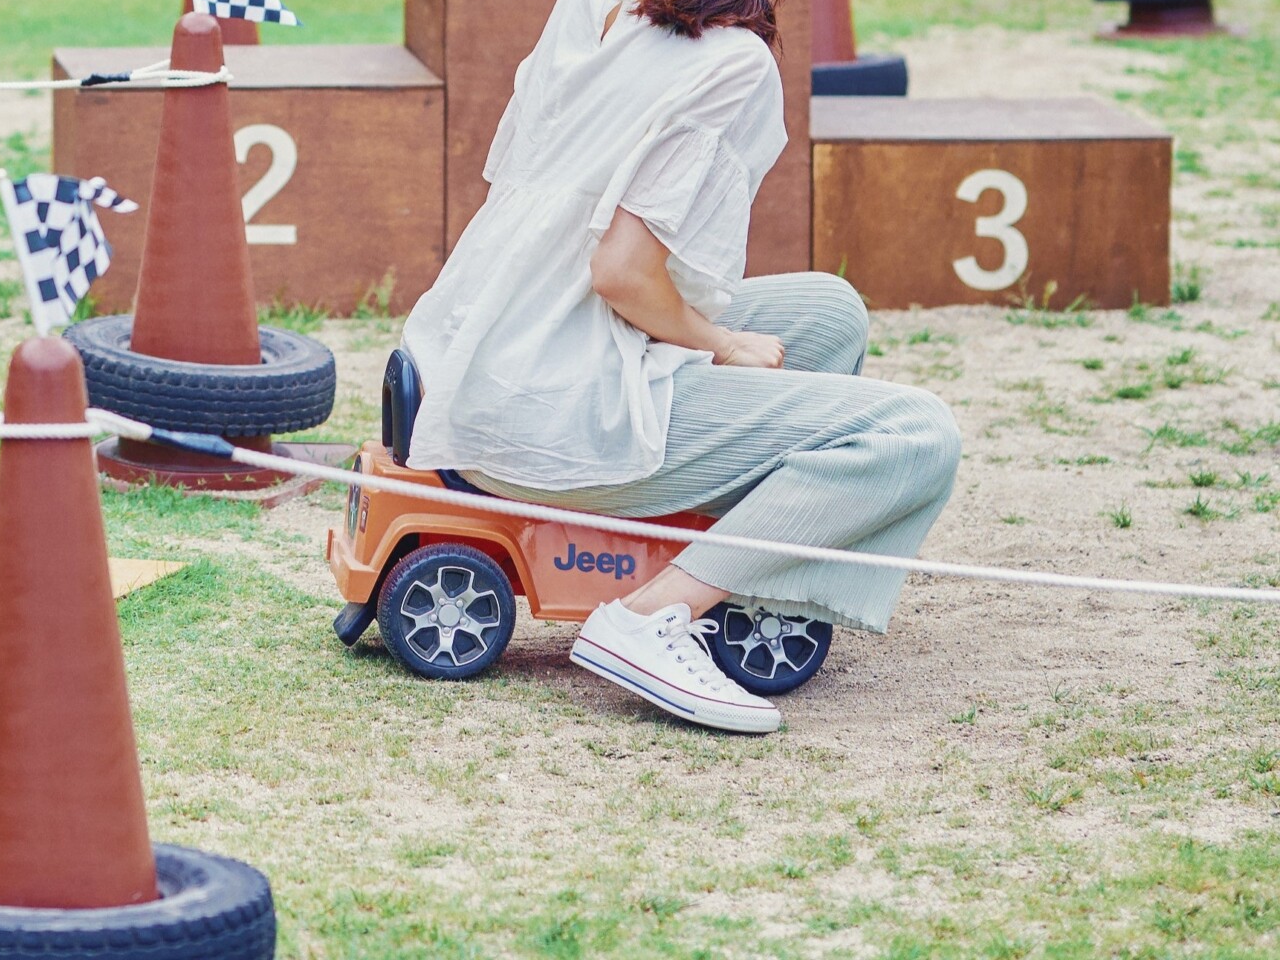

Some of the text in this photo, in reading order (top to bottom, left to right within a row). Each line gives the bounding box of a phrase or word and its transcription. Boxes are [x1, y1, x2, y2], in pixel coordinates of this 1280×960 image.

[233, 124, 297, 245] 2
[952, 168, 1028, 291] 3
[554, 543, 635, 580] Jeep
